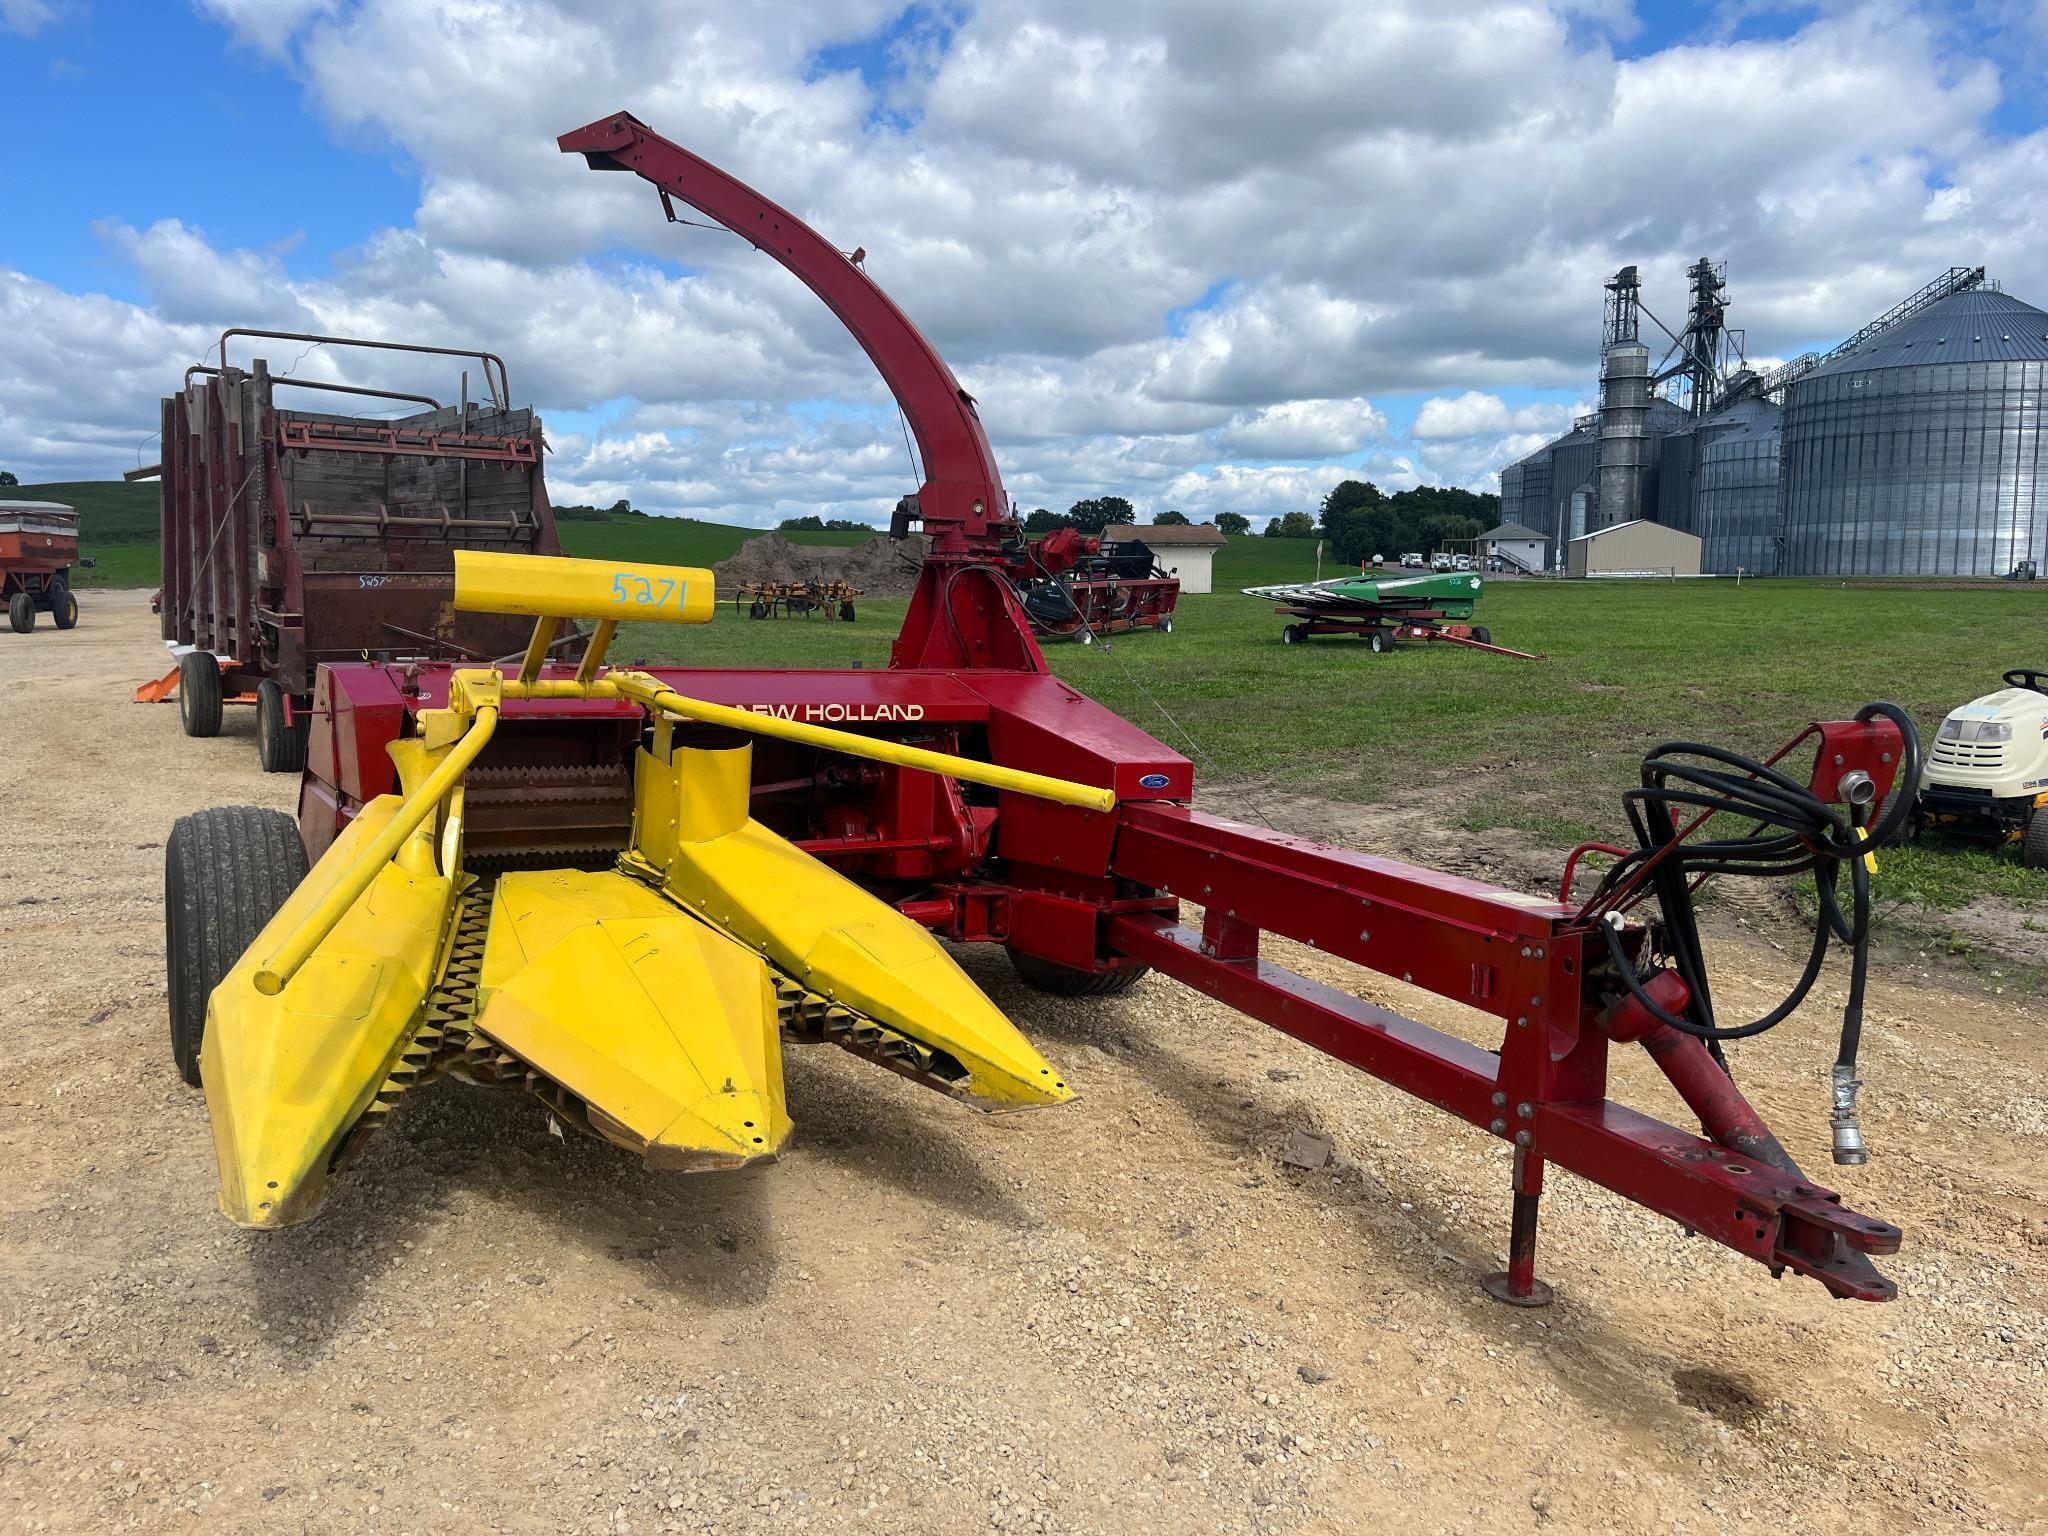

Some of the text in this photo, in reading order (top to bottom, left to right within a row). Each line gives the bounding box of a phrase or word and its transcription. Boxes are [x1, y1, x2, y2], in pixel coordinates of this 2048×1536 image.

[359, 575, 386, 588] 5257
[612, 572, 687, 610] 5271
[805, 703, 925, 722] HOLLAND
